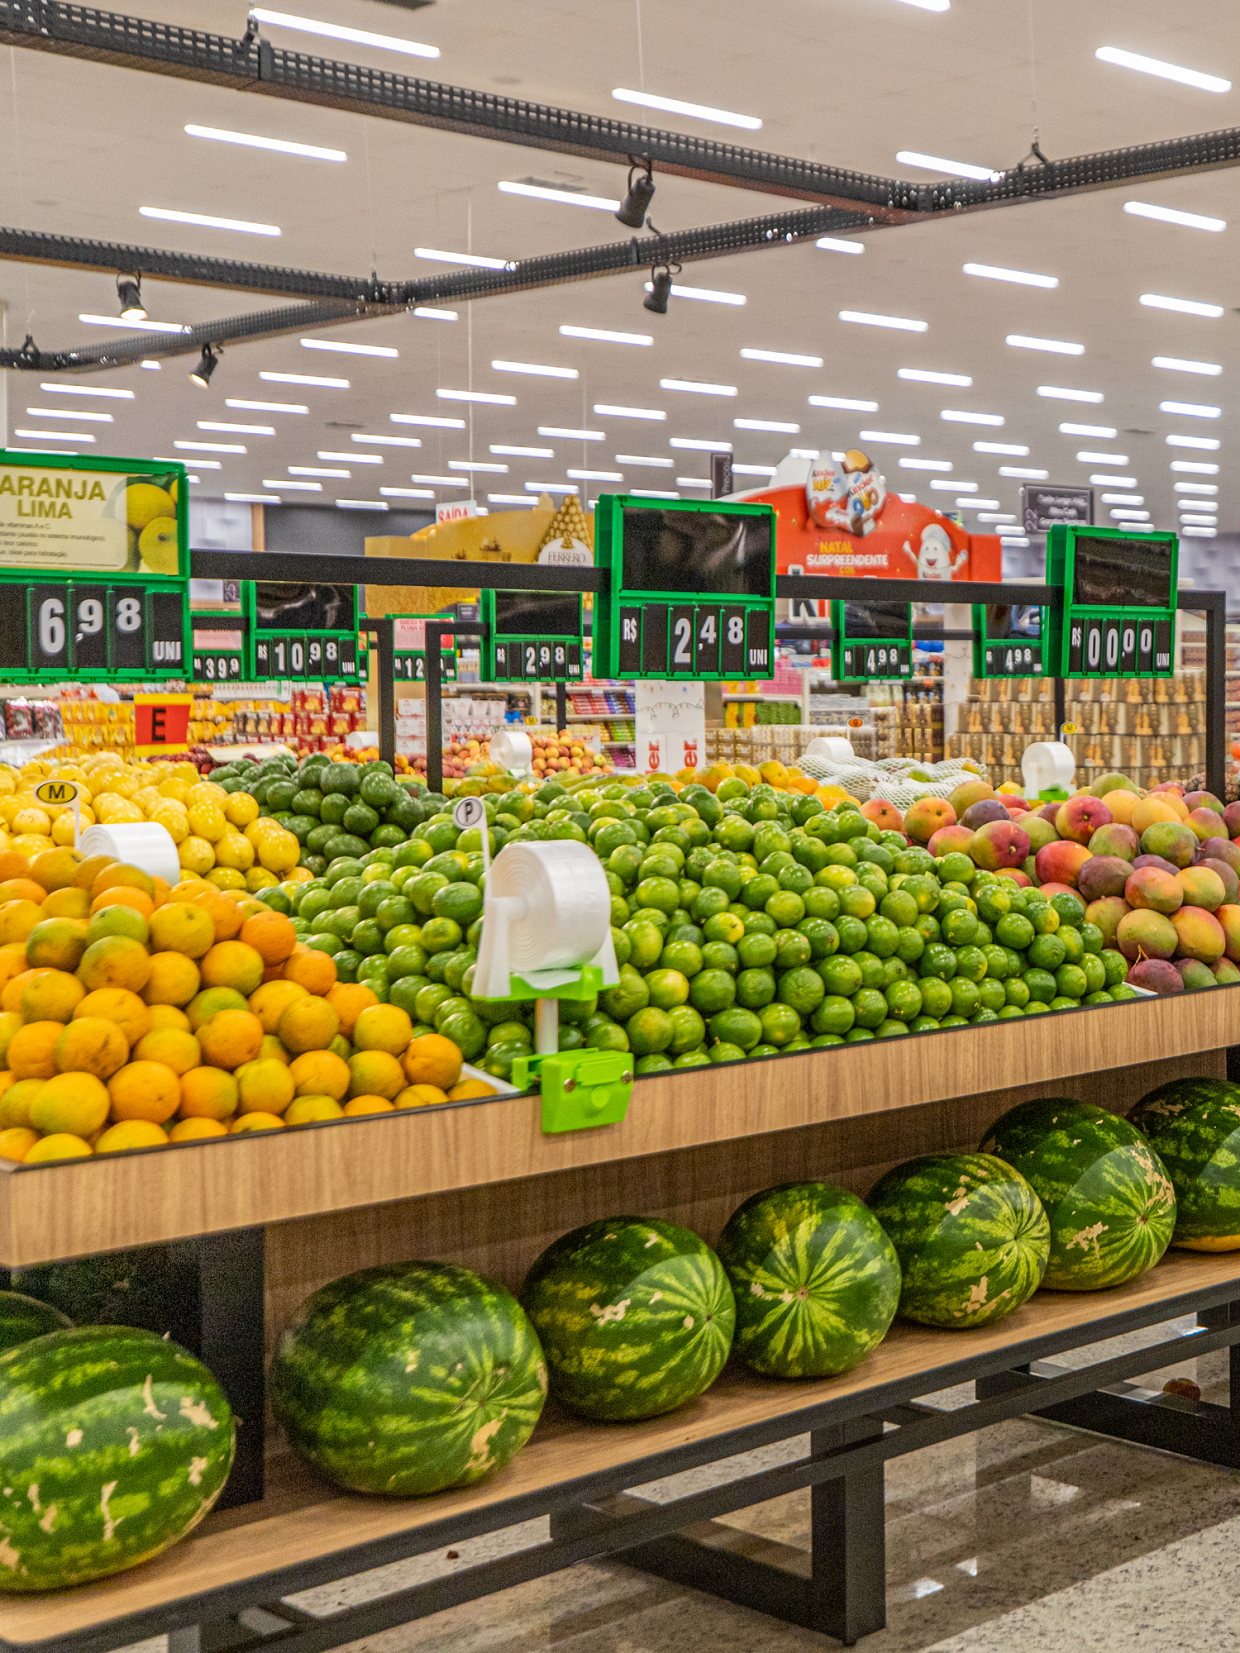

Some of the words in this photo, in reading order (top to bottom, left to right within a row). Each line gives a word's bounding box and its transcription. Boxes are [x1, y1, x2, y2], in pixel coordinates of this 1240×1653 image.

[17, 499, 73, 519] LIMA
[819, 541, 853, 554] NATAL
[806, 554, 888, 568] SURPREENDENTE
[153, 640, 182, 661] UNI
[623, 618, 637, 643] R$
[749, 649, 768, 666] UNI
[1072, 626, 1082, 647] R$
[1156, 652, 1170, 667] UNI
[342, 661, 355, 674] UNI
[152, 707, 166, 741] E
[49, 785, 65, 799] M
[464, 802, 473, 822] P
